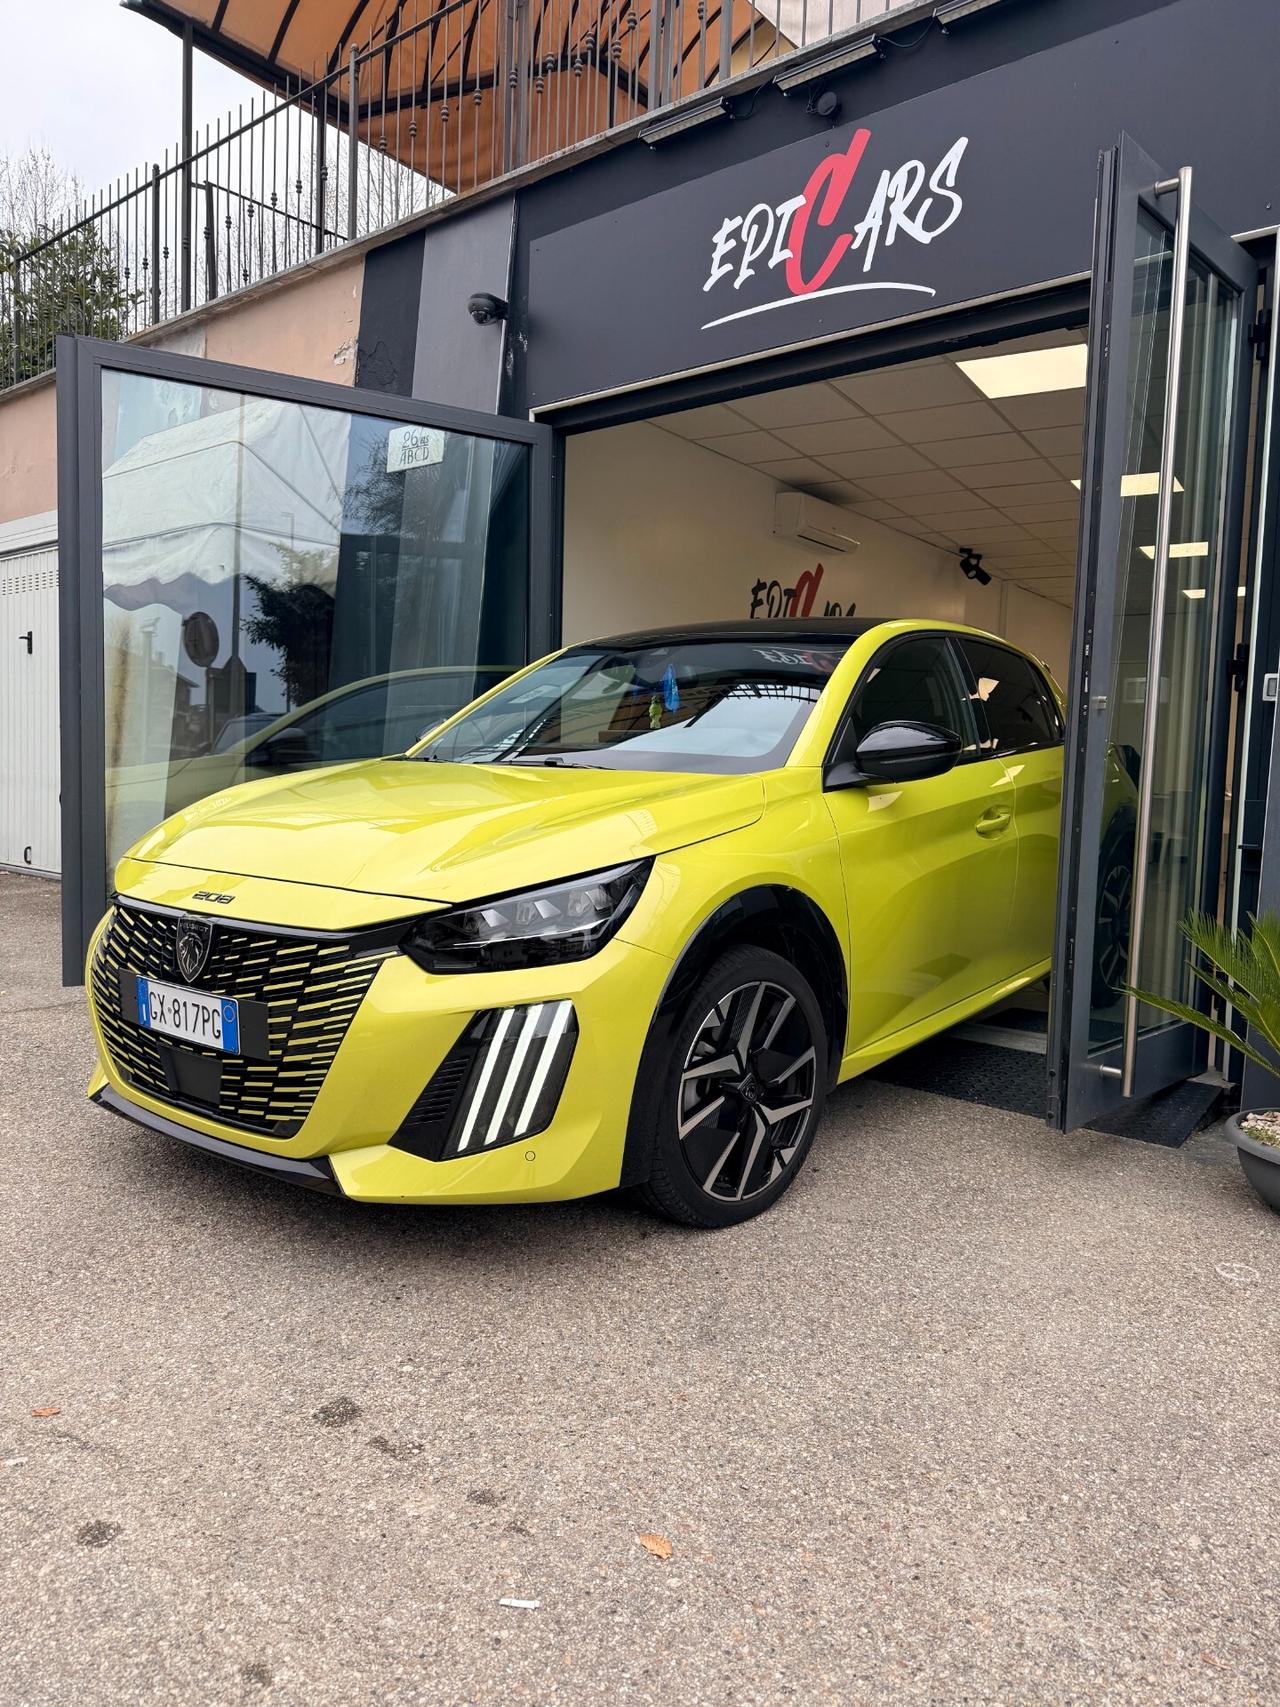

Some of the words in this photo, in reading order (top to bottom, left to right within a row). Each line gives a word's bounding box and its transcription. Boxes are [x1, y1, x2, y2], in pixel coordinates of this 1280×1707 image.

[702, 128, 969, 295] EPICARS
[399, 447, 430, 466] ABCD
[192, 890, 236, 905] 208
